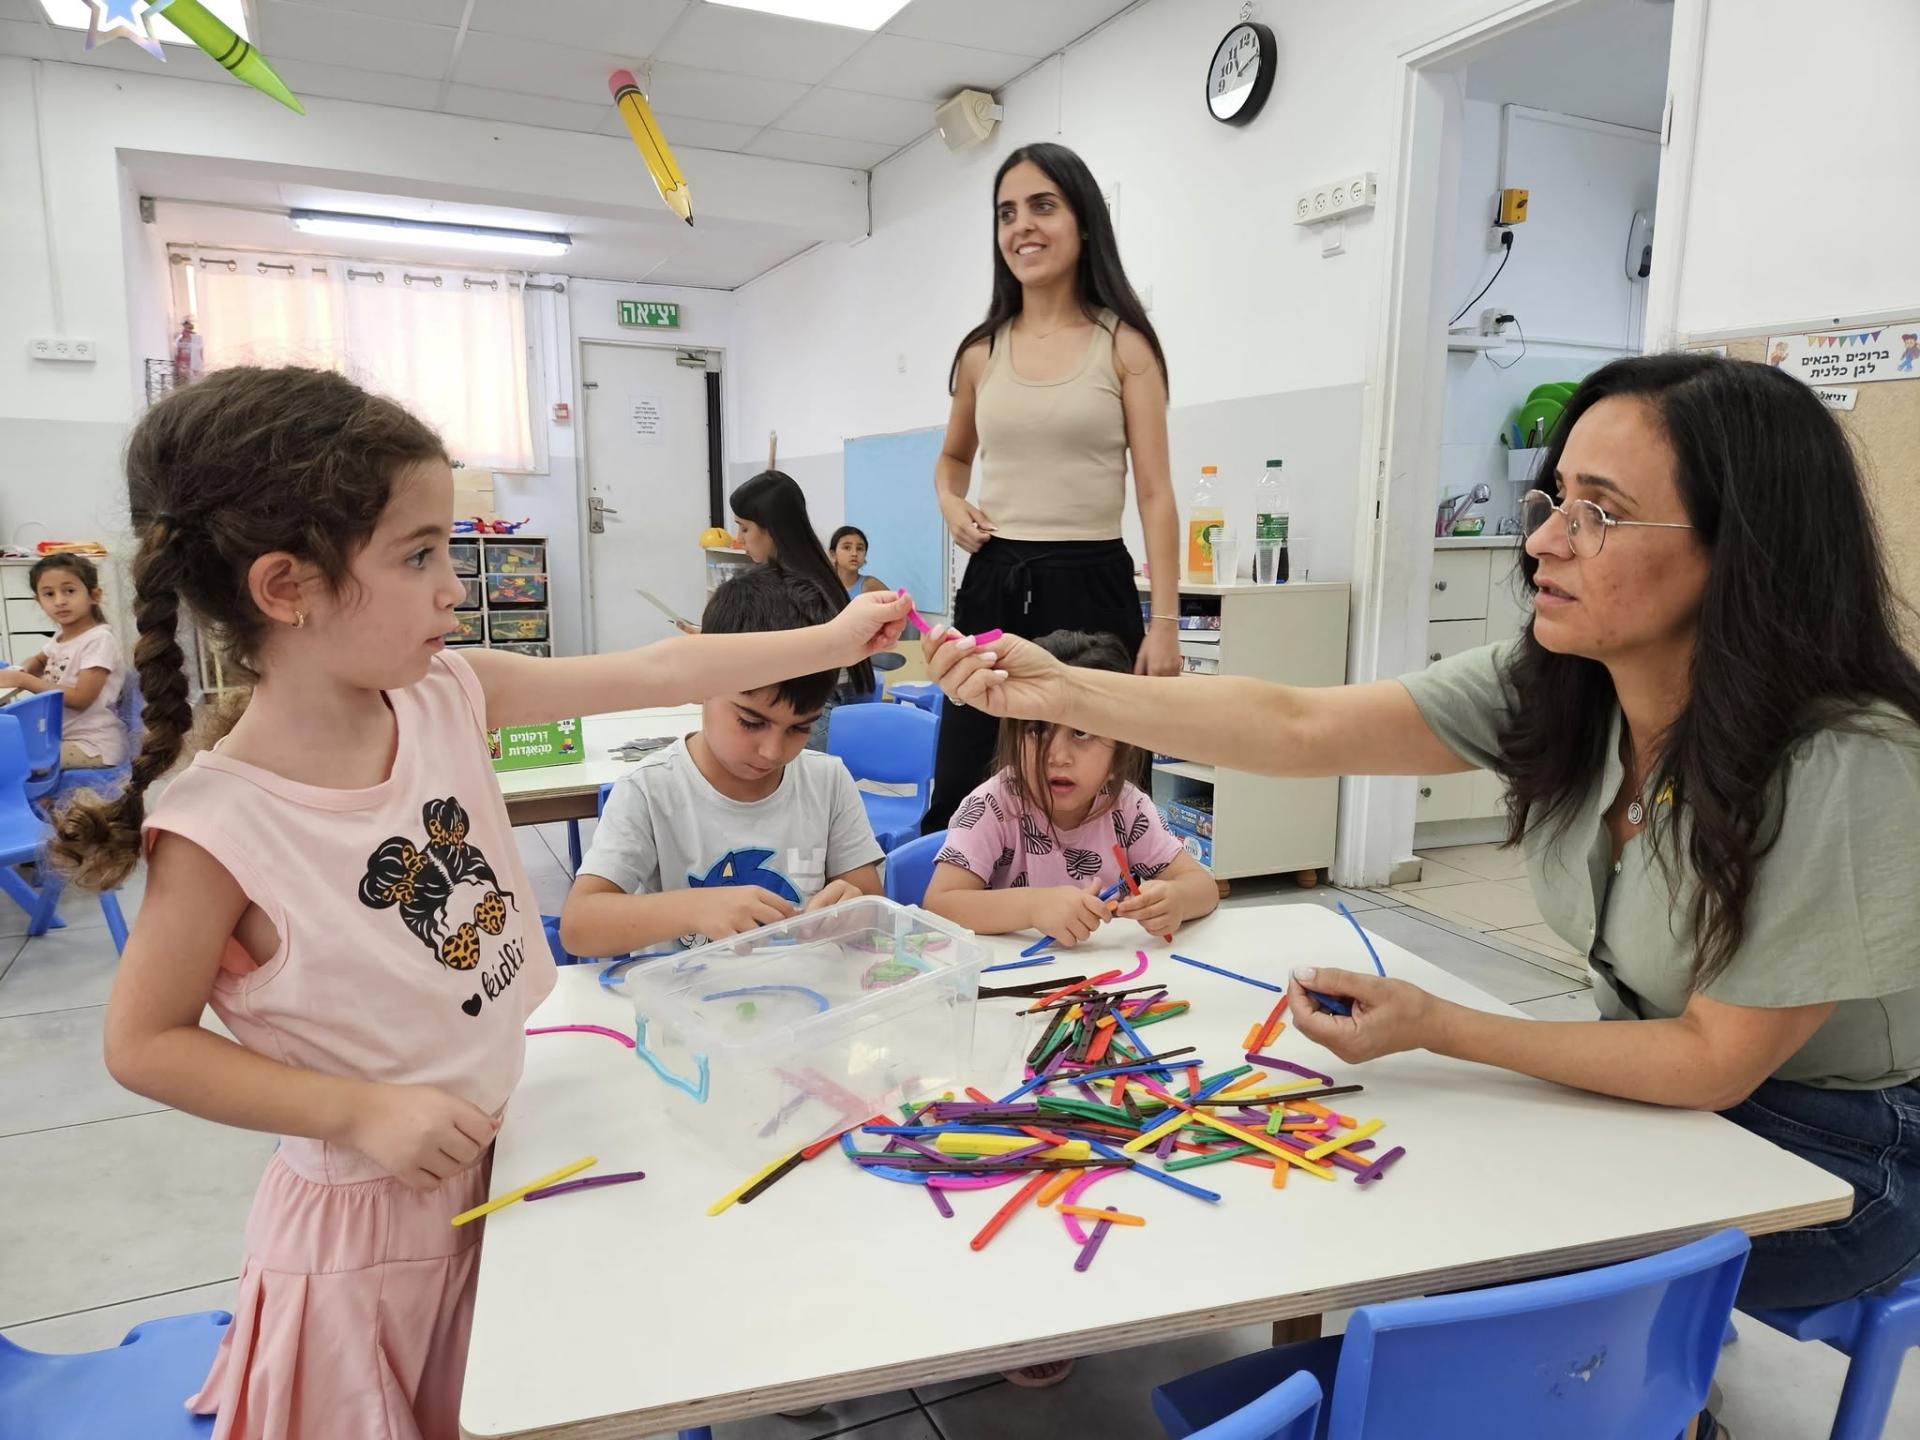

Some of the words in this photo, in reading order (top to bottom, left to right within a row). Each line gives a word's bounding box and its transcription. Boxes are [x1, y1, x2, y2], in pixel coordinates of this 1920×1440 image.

[1239, 32, 1250, 49] 12
[1251, 35, 1256, 48] 1
[1228, 45, 1238, 60] 11
[1221, 61, 1233, 78] 10
[1218, 79, 1225, 93] 9
[623, 302, 676, 325] יציאה
[1801, 354, 1840, 366] הבאים
[1846, 350, 1890, 362] ברוכים
[1809, 365, 1848, 378] כלנית
[1854, 362, 1876, 378] לגן
[1819, 391, 1847, 402] דניאל
[481, 936, 525, 1002] kidli
